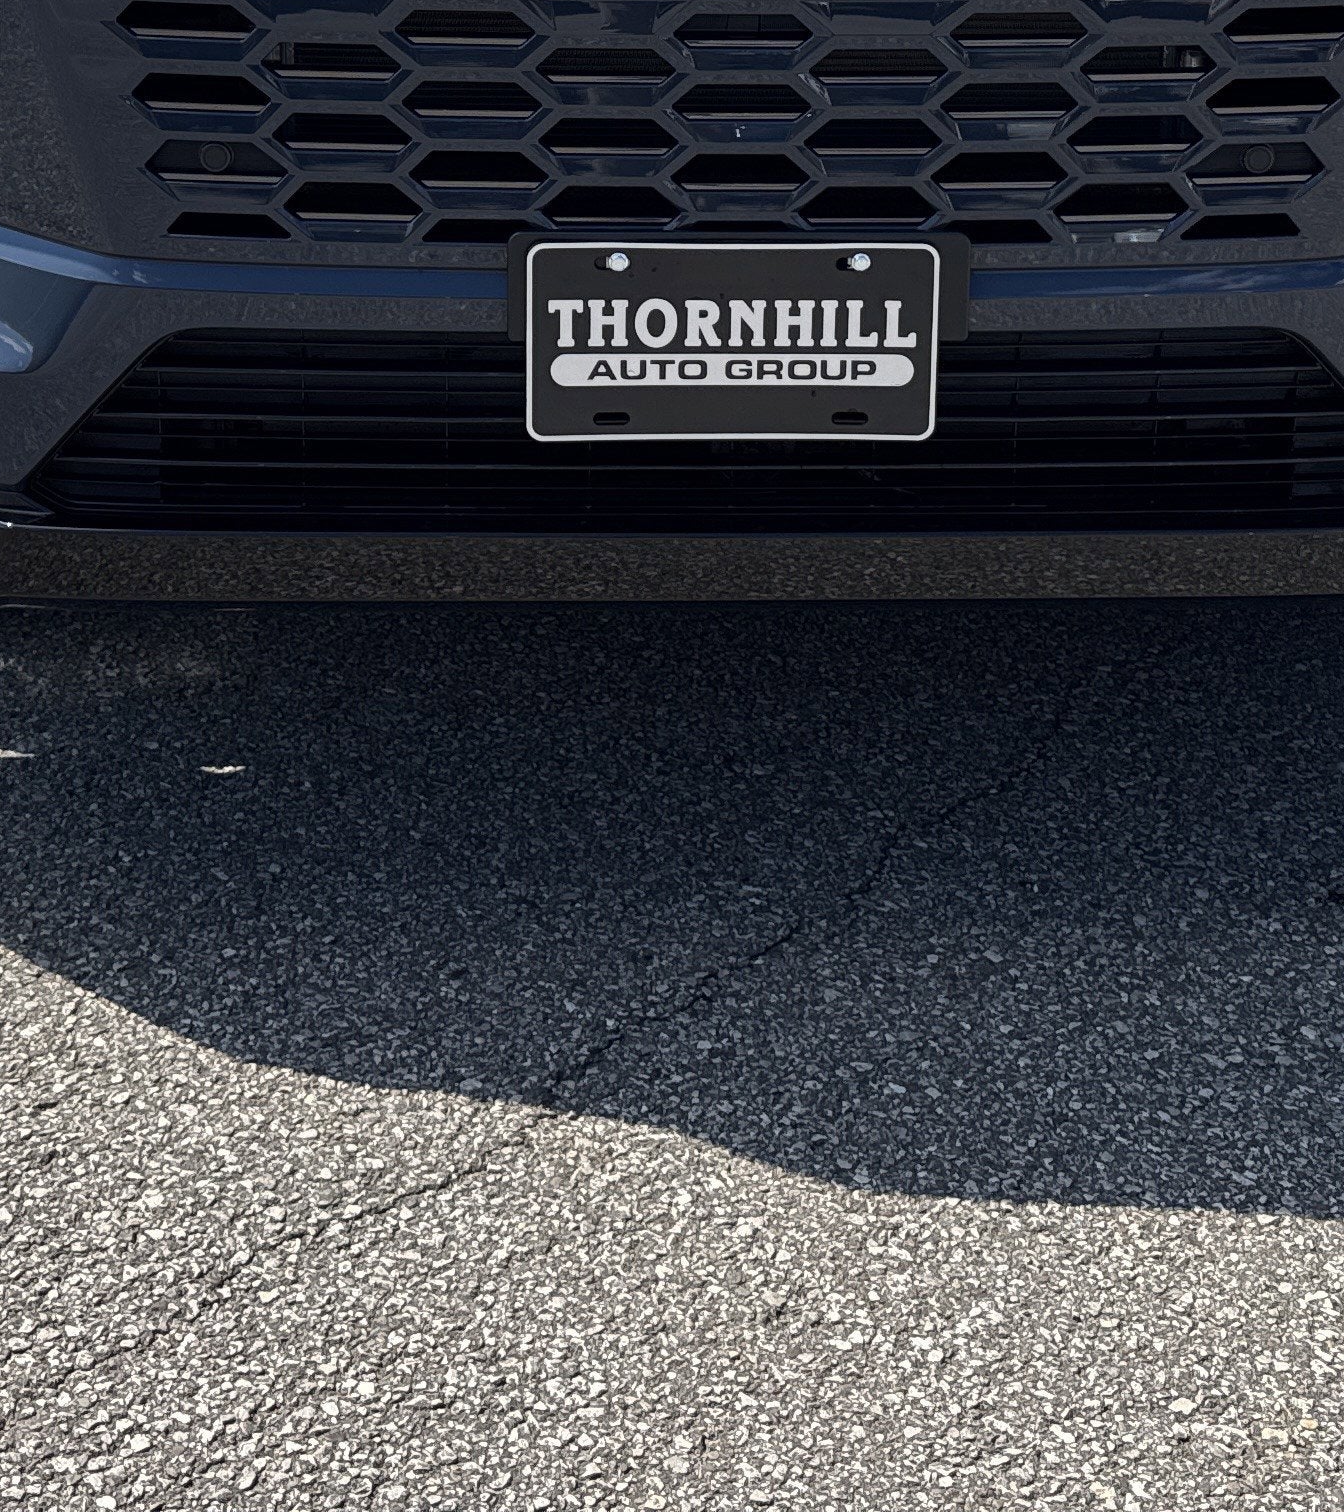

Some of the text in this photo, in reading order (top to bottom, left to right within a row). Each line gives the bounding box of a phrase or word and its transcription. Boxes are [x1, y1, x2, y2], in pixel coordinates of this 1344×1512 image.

[547, 297, 917, 348] THORNHILL
[587, 359, 878, 381] AUTO GROUP
